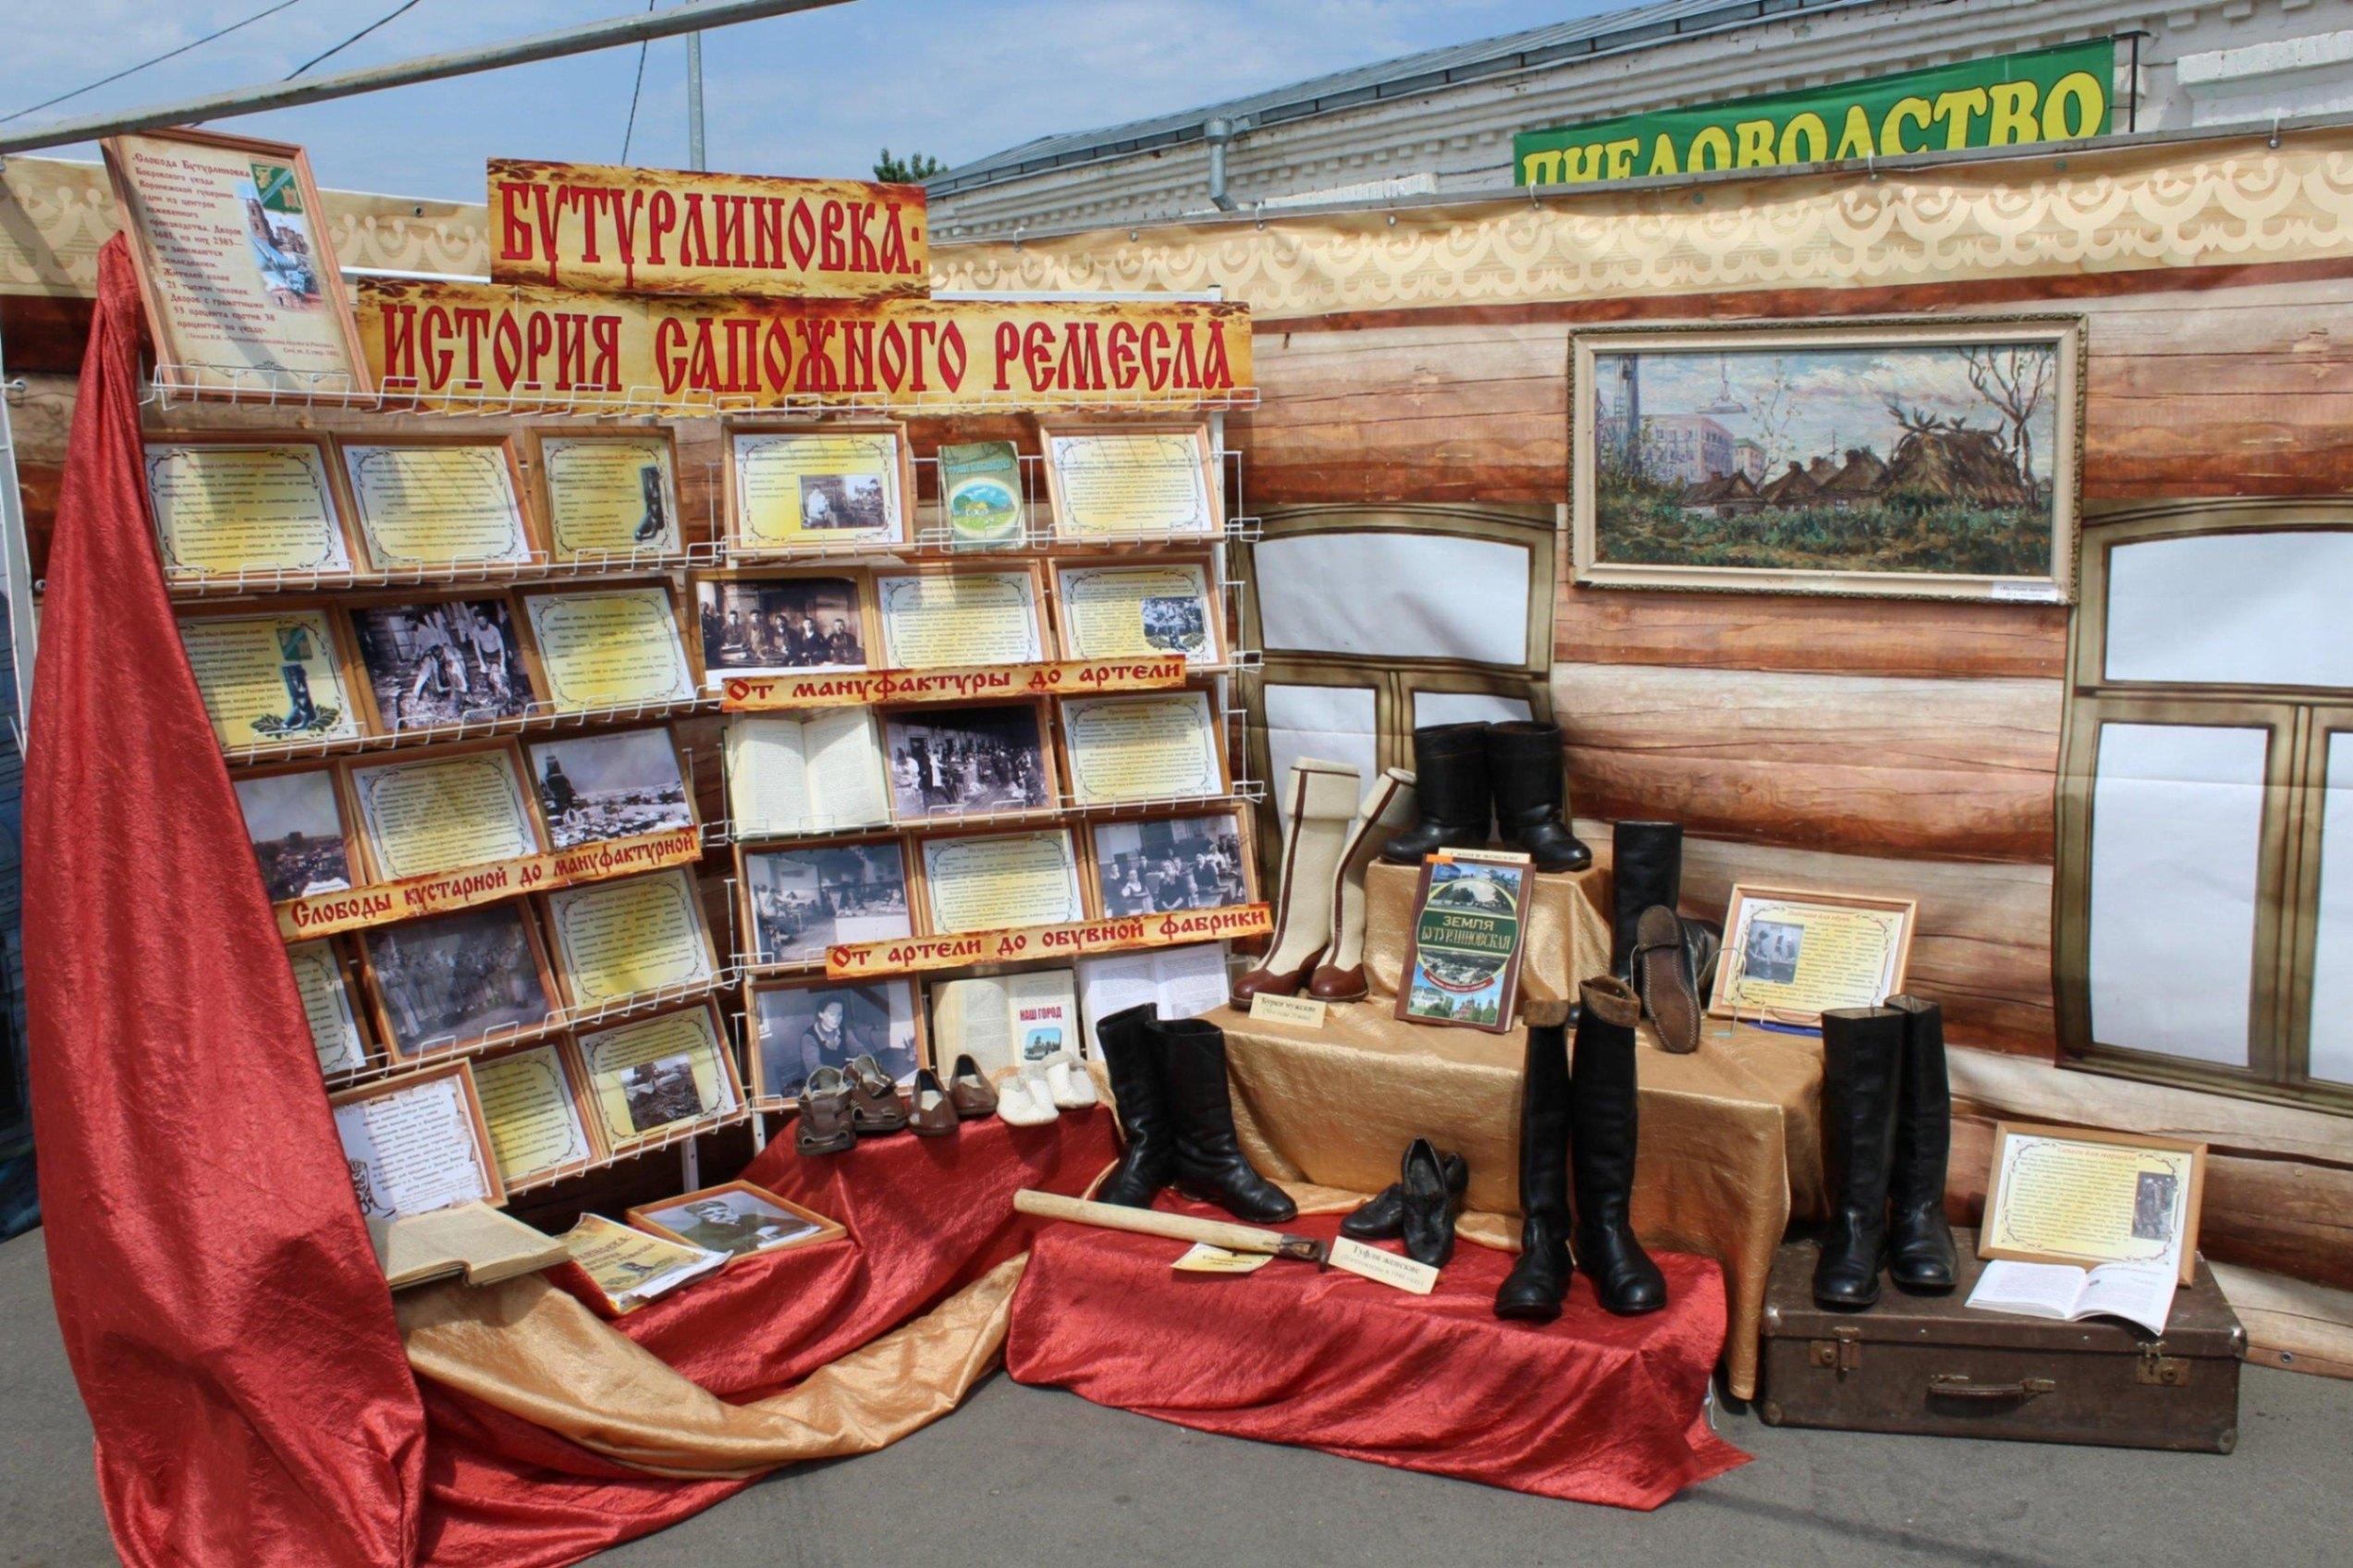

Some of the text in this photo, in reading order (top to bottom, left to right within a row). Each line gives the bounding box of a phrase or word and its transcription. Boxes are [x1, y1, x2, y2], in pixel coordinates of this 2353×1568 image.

[498, 181, 922, 289] БУТУРЛИНОВКА:
[379, 303, 1234, 395] ИСТОРИЯ САПОЖНОГО РЕМЕСЛА
[727, 661, 1181, 702] От мануфактуры до артели
[290, 832, 694, 928] Слободы кустарной до мануфактурной
[832, 911, 1266, 968] От артели до обувной фабрики
[1442, 915, 1494, 930] ЗЕМЛЯ
[1038, 1007, 1062, 1020] ГОРОД
[1354, 1245, 1420, 1274] Туфли женские
